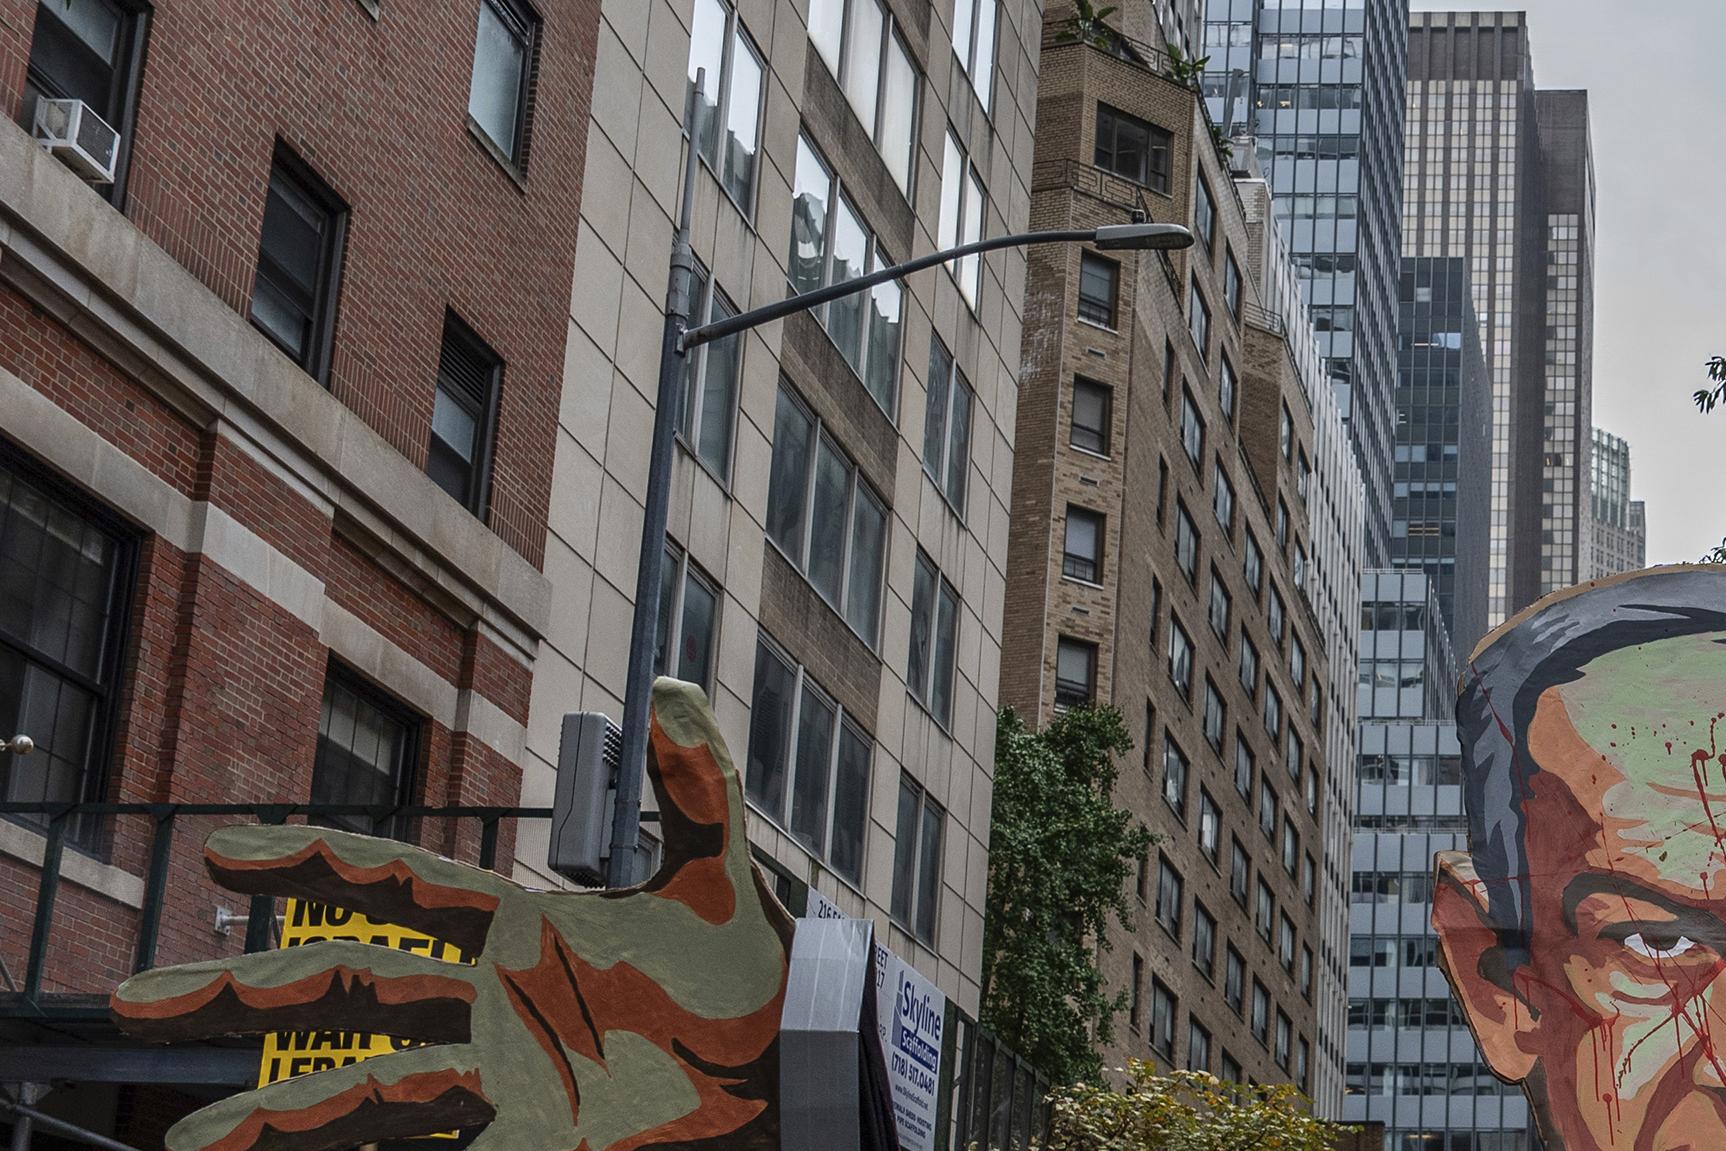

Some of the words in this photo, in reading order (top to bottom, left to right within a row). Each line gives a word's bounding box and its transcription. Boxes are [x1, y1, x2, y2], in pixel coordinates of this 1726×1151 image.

[902, 981, 941, 1041] Skyline
[892, 1051, 908, 1079] (718)
[902, 1030, 937, 1072] Scaffolding
